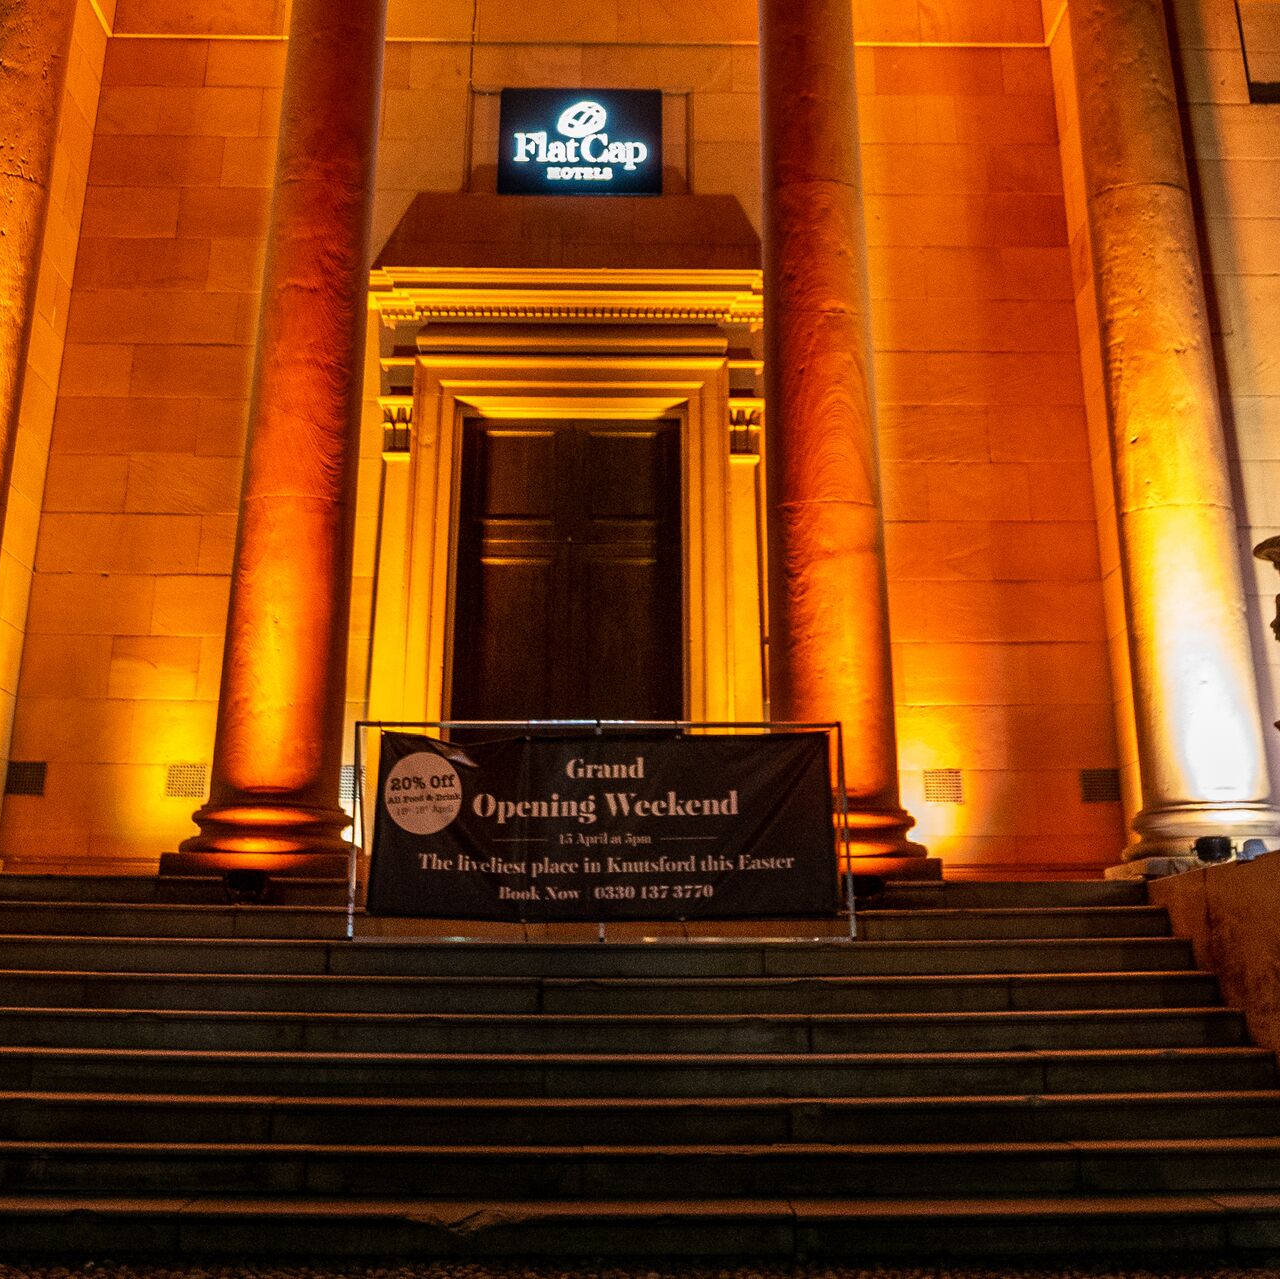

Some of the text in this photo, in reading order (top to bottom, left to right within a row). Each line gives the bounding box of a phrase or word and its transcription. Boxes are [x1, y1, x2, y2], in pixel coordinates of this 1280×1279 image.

[513, 131, 648, 170] Flat Cap
[547, 166, 613, 181] HOTELS
[566, 756, 645, 779] Grand
[390, 774, 456, 791] 20% Off
[403, 795, 424, 804] Food
[435, 793, 460, 802] Drink
[472, 789, 739, 824] Opening Weekend
[559, 831, 652, 847] 15 April at 5pm
[418, 852, 795, 878] The liveliest place in Knutsford this Easter
[498, 884, 714, 901] Book Now 0330 137 3770
